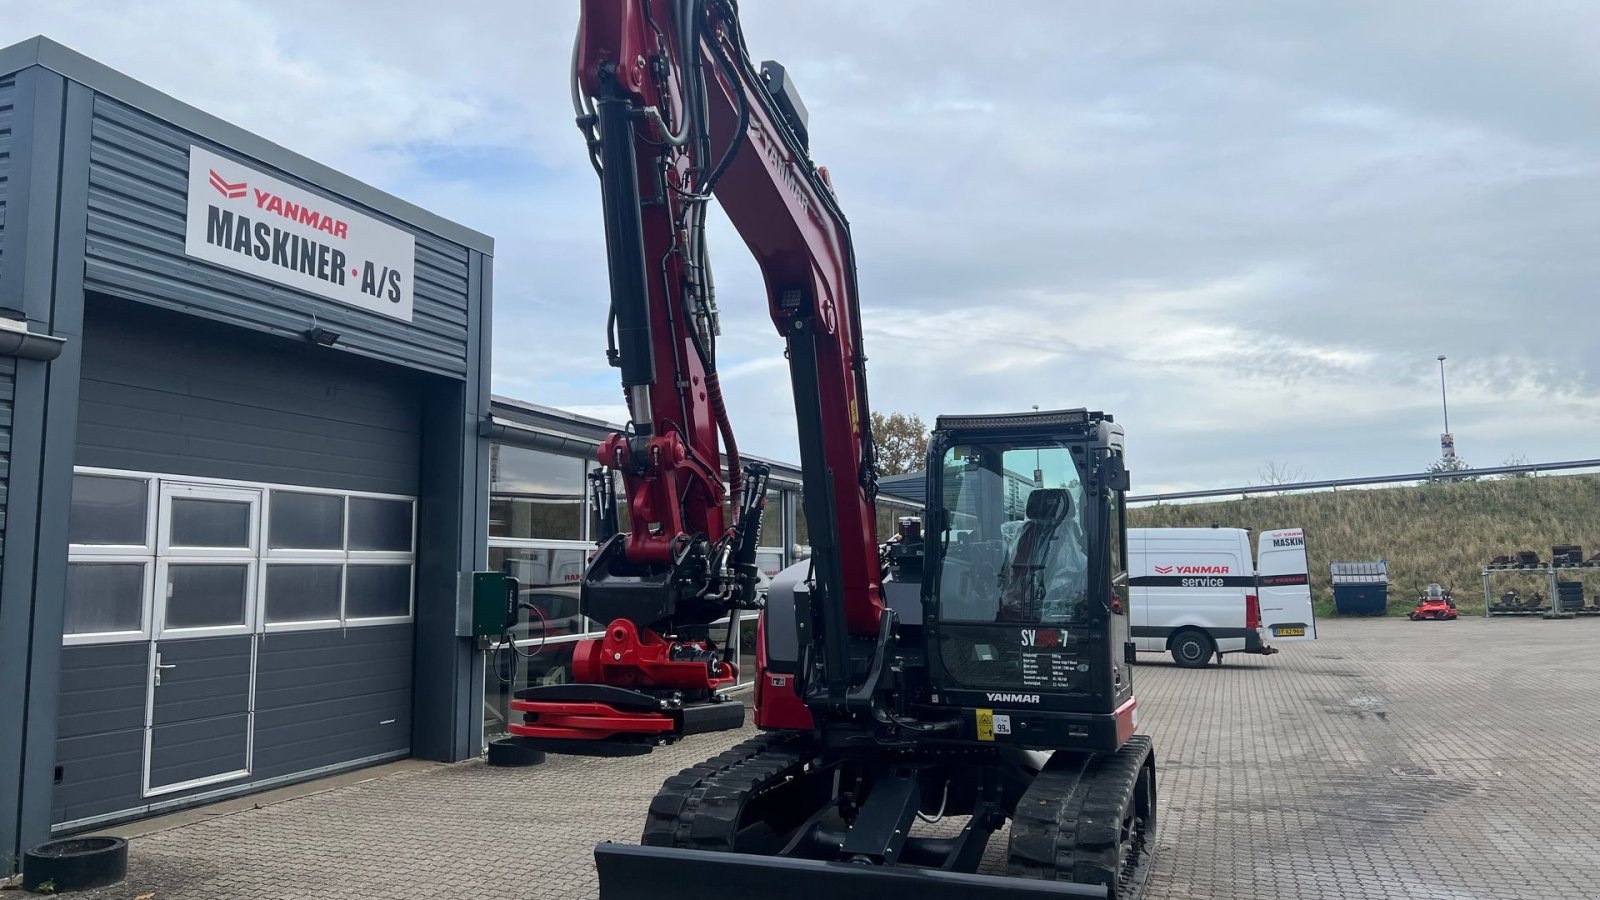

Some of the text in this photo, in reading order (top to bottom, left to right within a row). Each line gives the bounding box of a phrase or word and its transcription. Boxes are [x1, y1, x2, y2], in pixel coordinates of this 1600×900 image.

[763, 131, 810, 213] YANMAR
[254, 188, 349, 240] YANMAR
[206, 205, 402, 304] MASKINER A/S
[1273, 537, 1304, 547] MASKIN
[1176, 566, 1230, 574] YANMAR
[1181, 577, 1224, 587] service
[986, 693, 1040, 704] YANMAR
